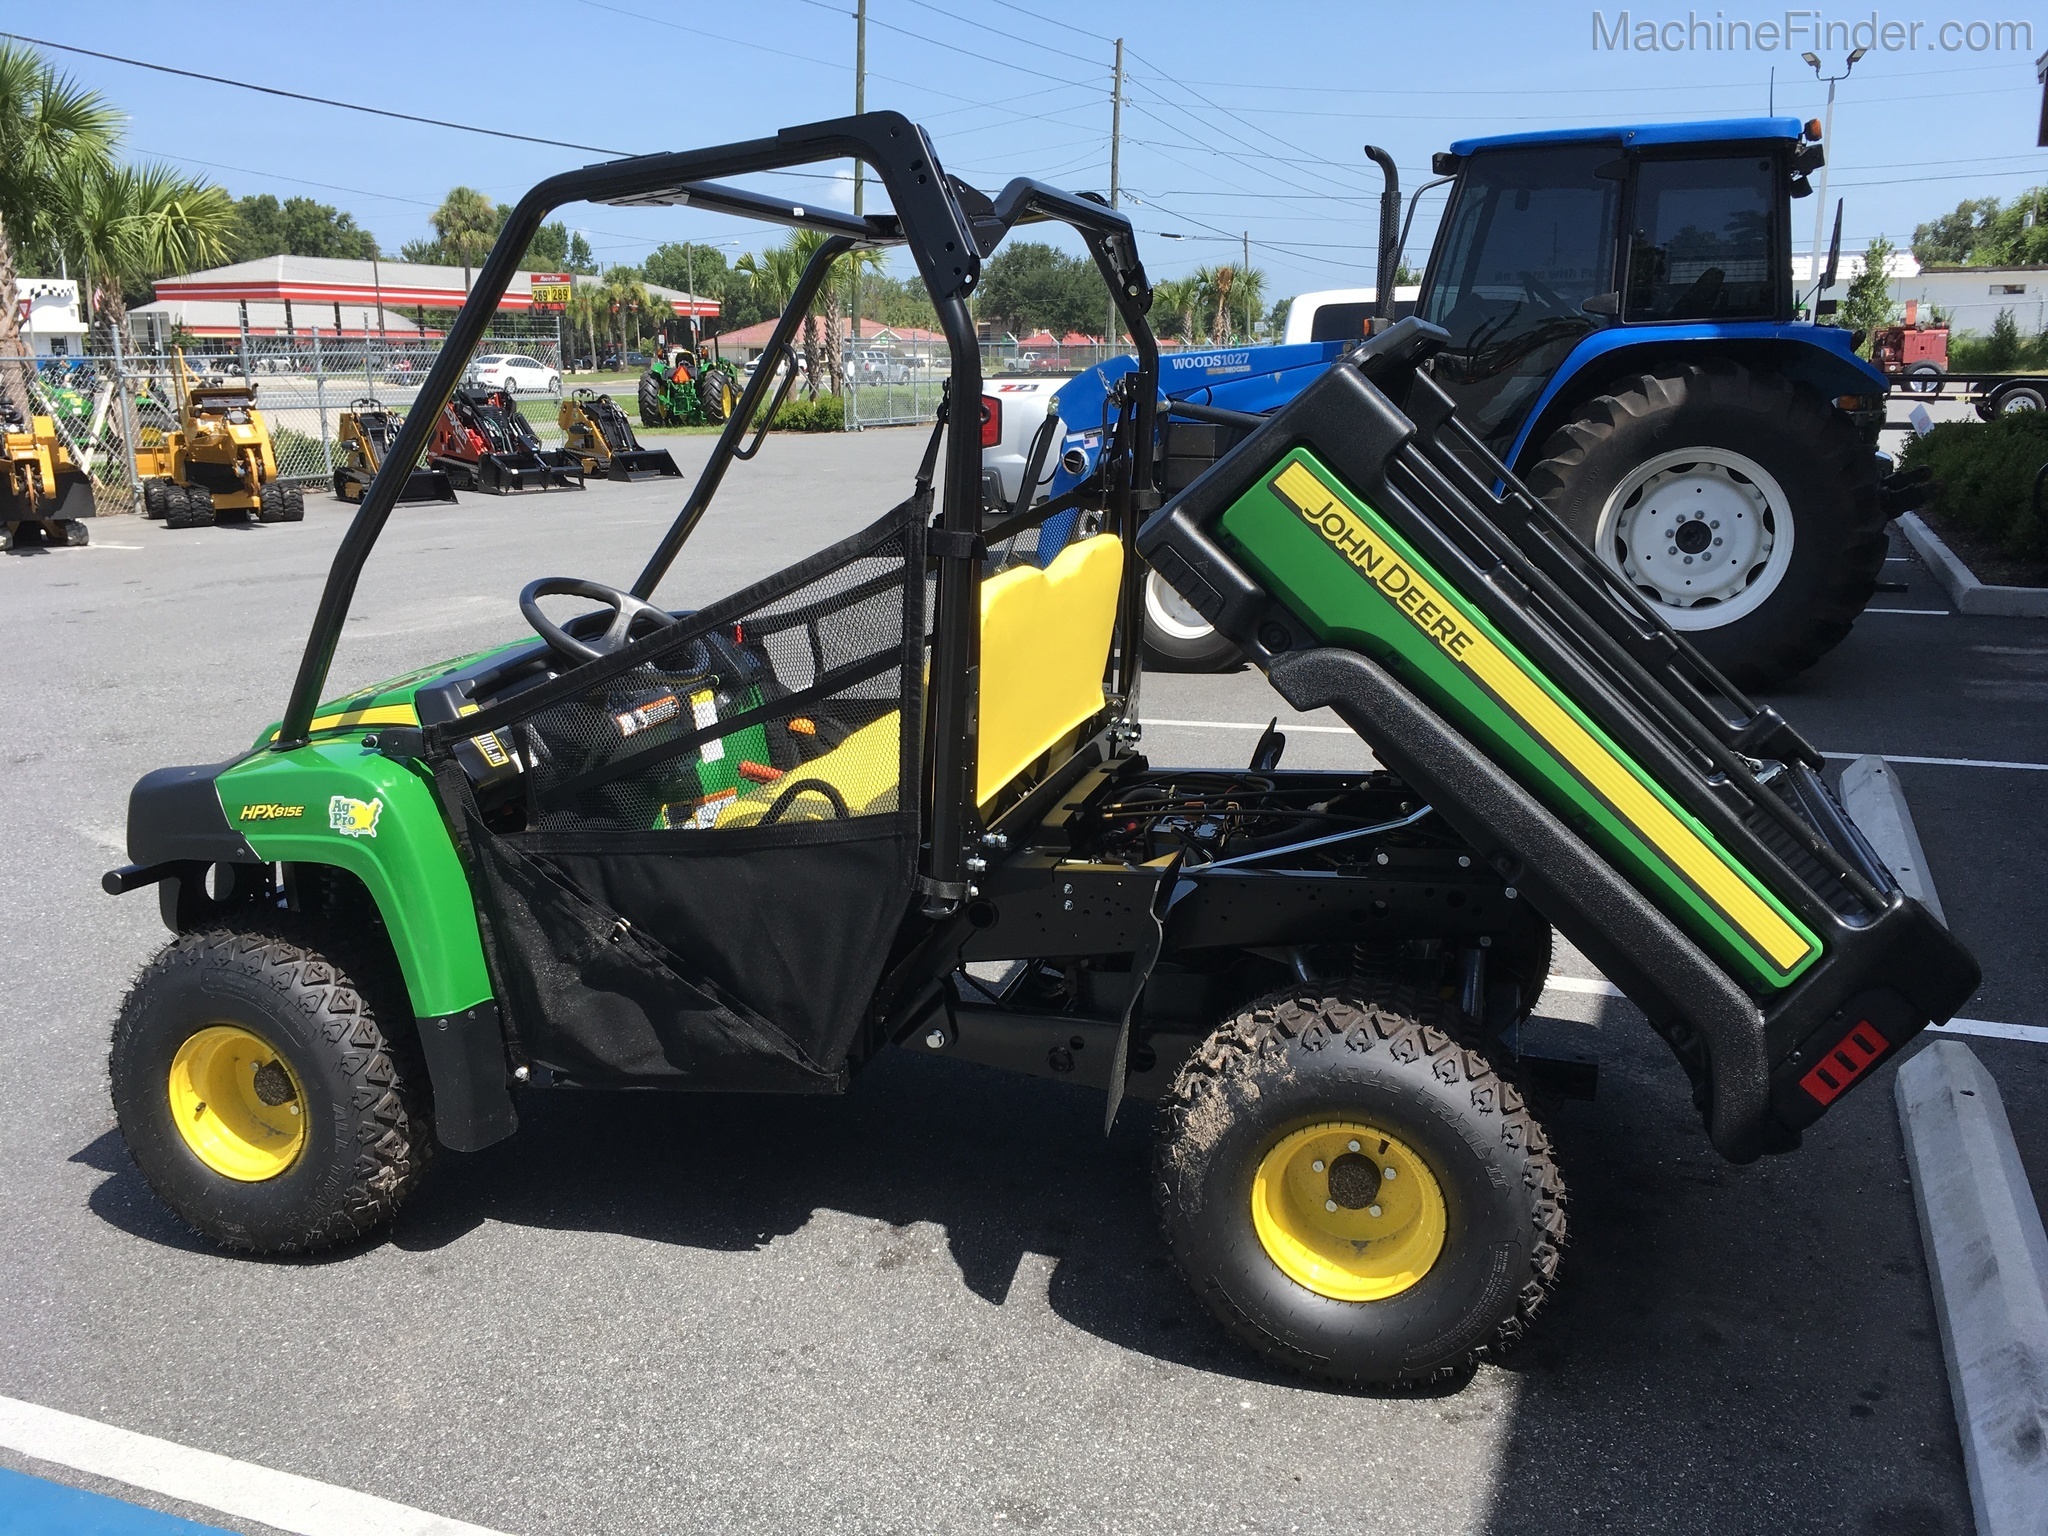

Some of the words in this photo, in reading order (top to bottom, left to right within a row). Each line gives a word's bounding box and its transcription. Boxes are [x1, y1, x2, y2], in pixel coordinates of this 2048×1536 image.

[1303, 501, 1385, 573] JOHN
[1378, 563, 1475, 657] DEERE
[239, 803, 305, 821] HPX815E
